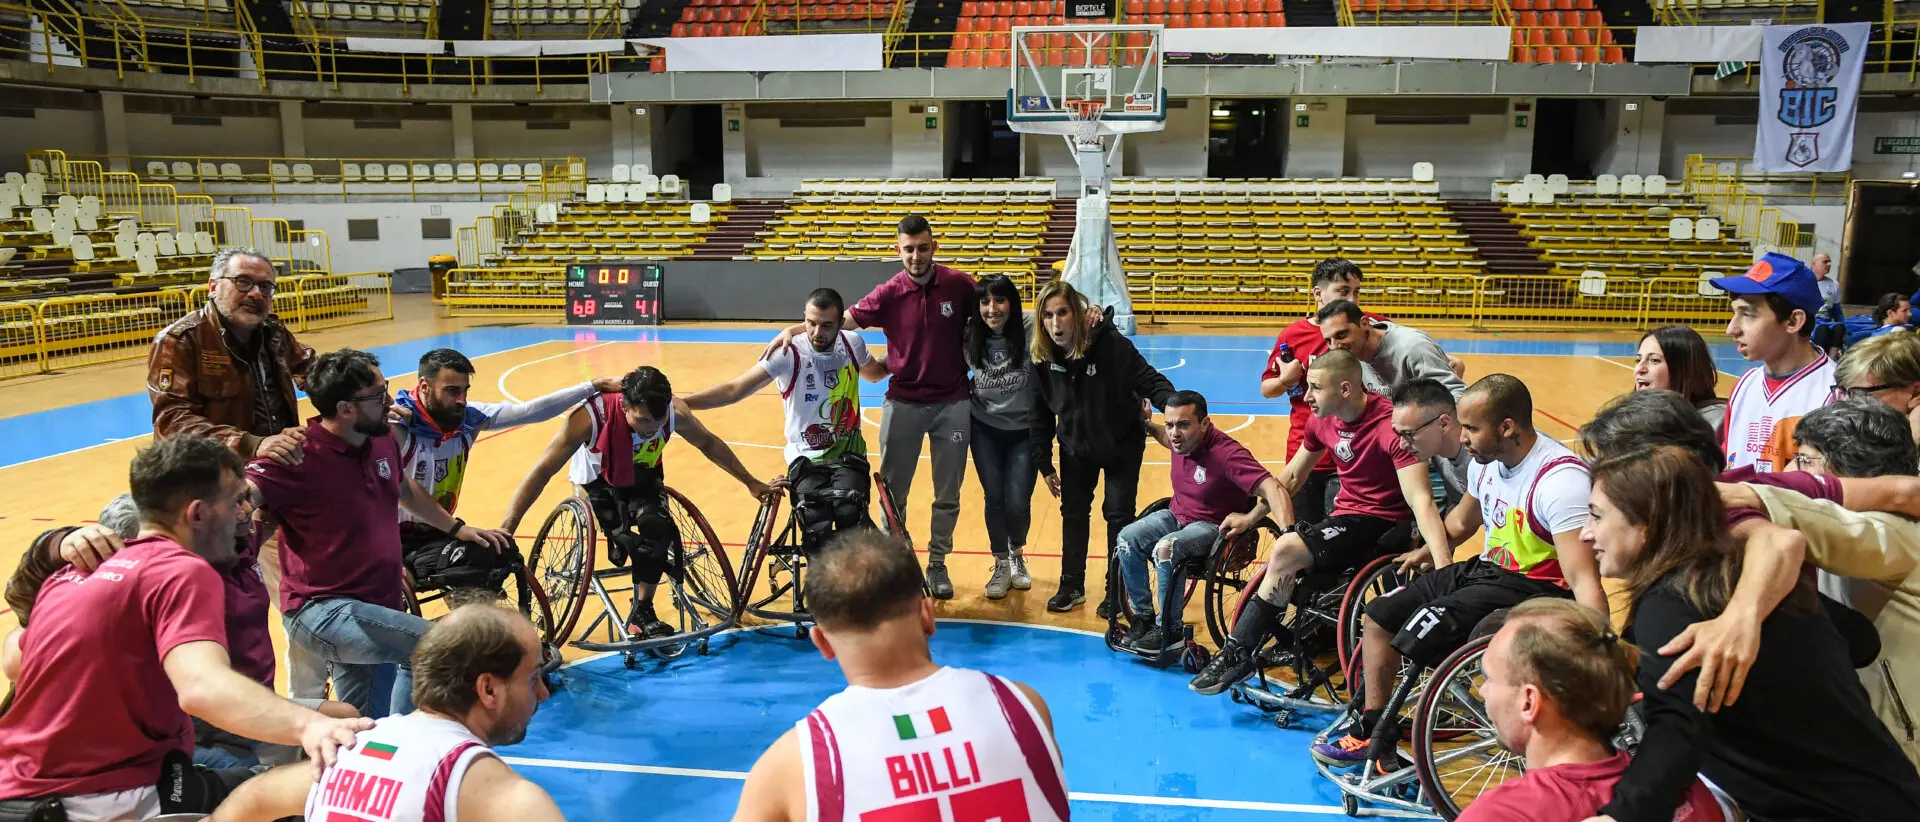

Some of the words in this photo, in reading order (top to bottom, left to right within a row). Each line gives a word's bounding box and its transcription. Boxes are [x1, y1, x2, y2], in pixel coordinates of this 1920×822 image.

[1778, 88, 1838, 128] BIC
[577, 268, 585, 279] 4
[573, 299, 596, 315] 68
[635, 299, 658, 315] 41
[885, 741, 981, 799] BILLI
[322, 768, 404, 820] HAMDI
